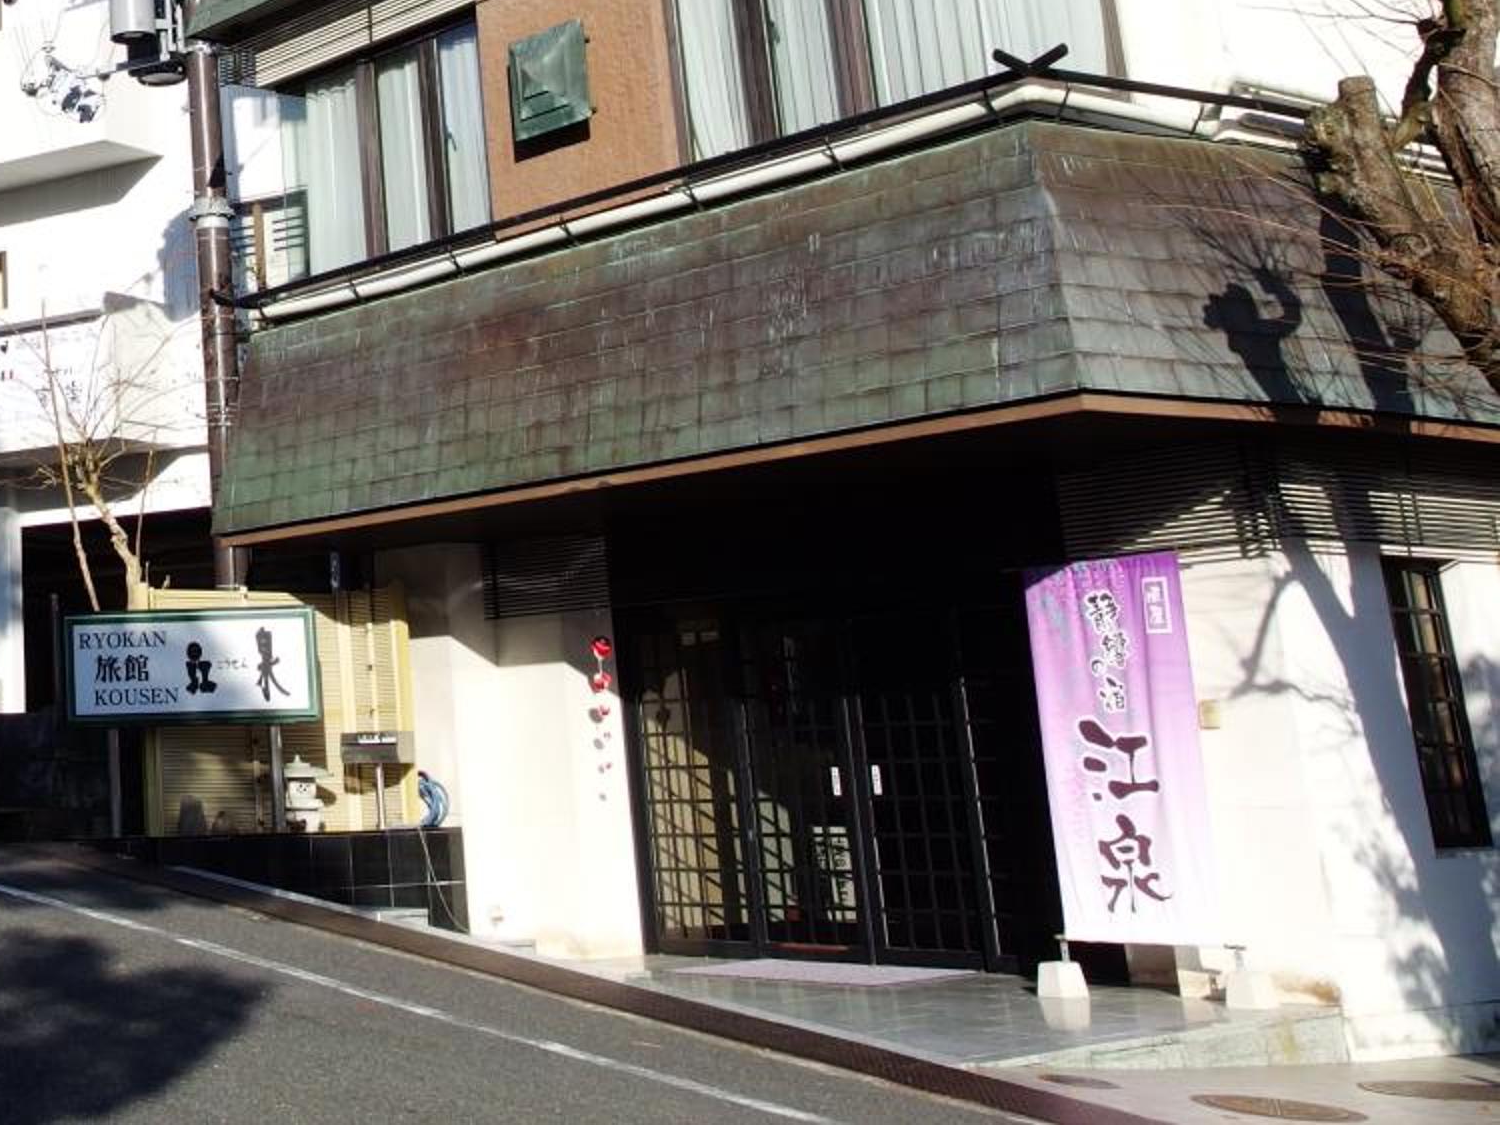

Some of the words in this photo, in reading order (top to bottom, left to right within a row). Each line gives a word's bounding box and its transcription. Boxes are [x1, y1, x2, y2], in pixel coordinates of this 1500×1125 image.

[79, 630, 167, 650] RYOKAN
[95, 654, 149, 683] 旅館
[216, 657, 250, 670] こうせん
[94, 688, 179, 707] KOUSEN
[1077, 720, 1173, 914] 江泉
